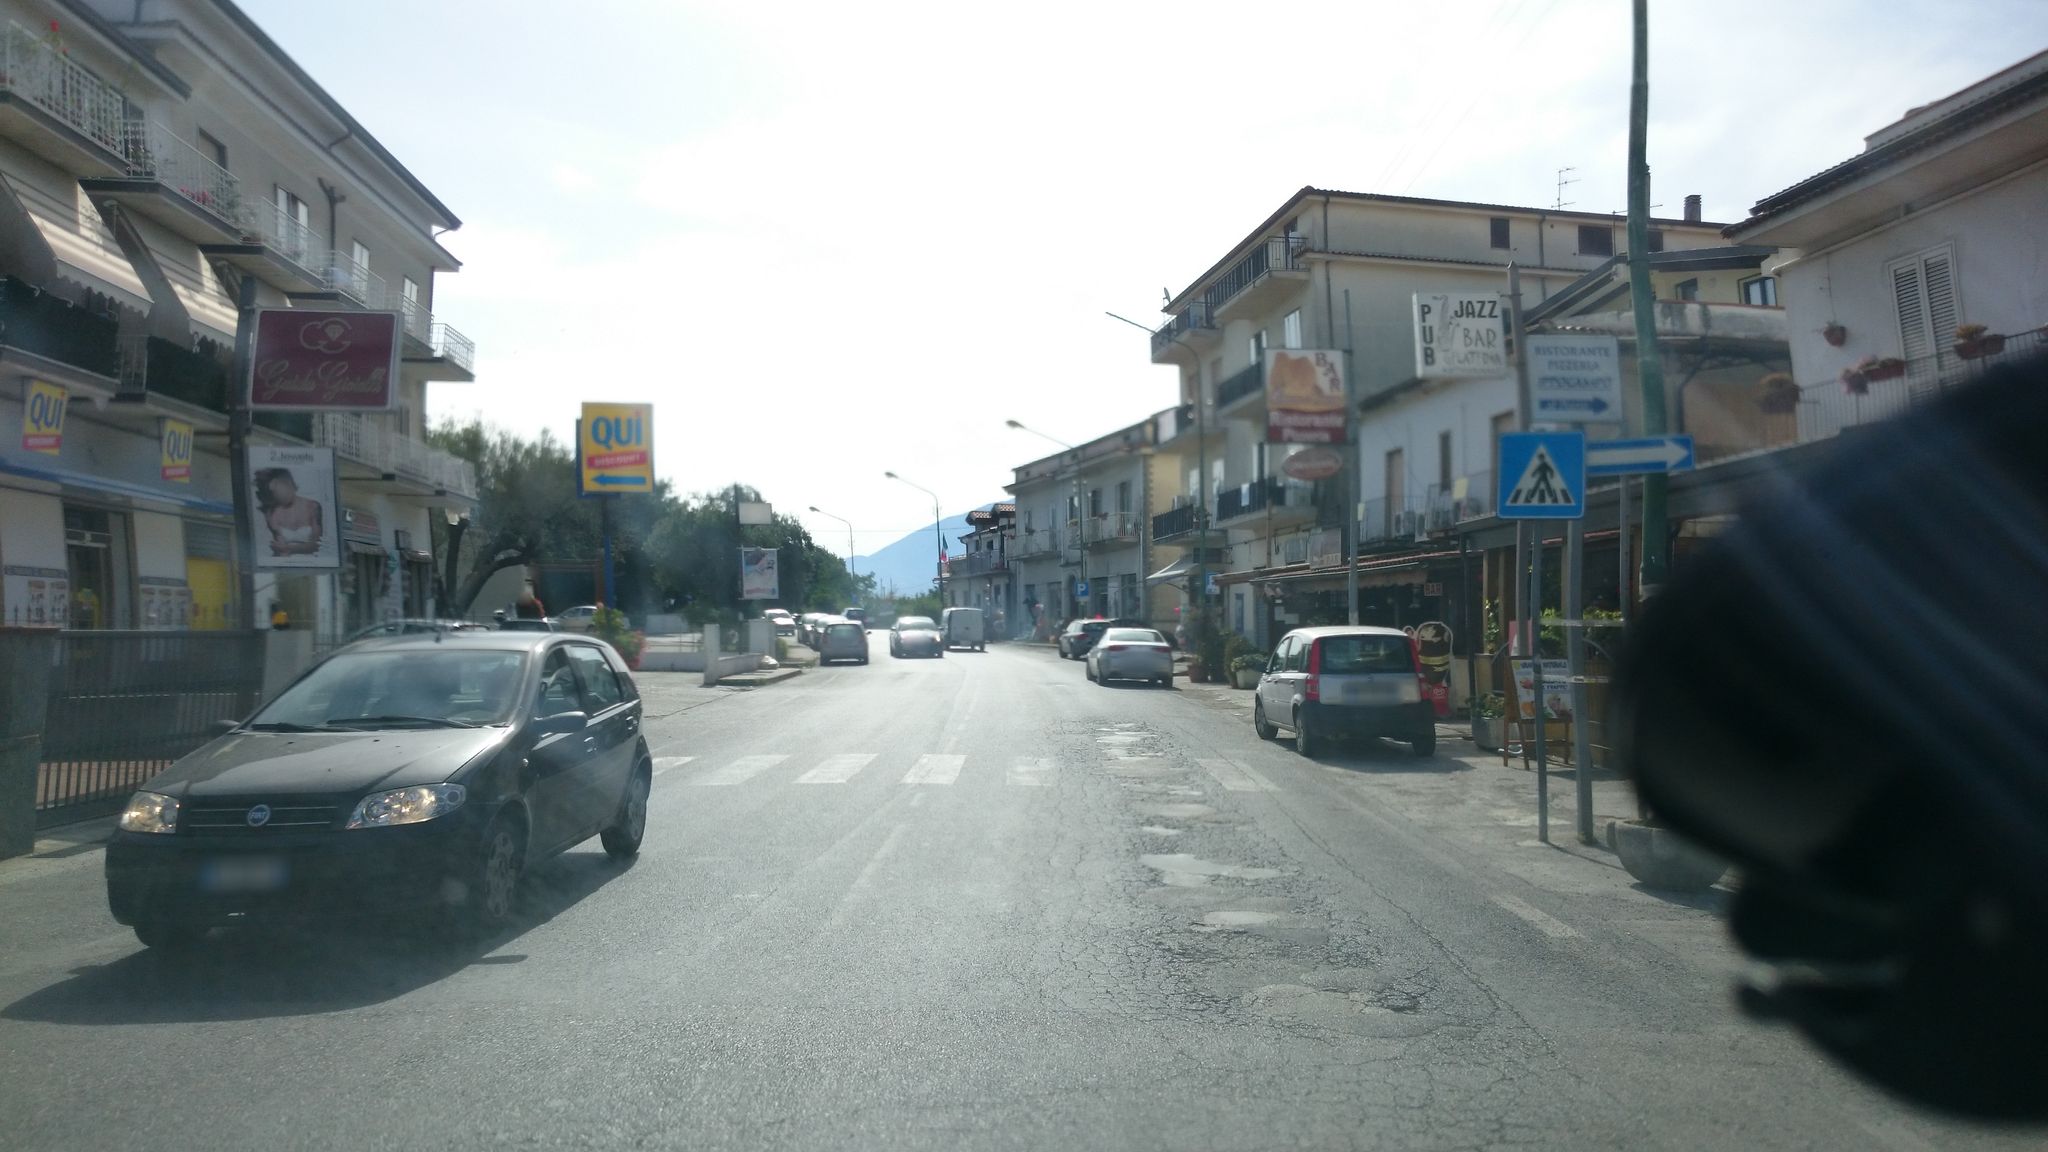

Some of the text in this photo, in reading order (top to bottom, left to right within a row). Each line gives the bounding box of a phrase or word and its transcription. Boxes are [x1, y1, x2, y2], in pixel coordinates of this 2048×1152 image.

[1454, 300, 1498, 319] JAZZ
[1420, 304, 1435, 366] PUB
[1463, 328, 1496, 348] BAR
[1534, 346, 1609, 357] RISTORANTE
[1315, 352, 1340, 391] BAR
[1548, 360, 1599, 370] PIZZERIA
[1077, 583, 1086, 595] P
